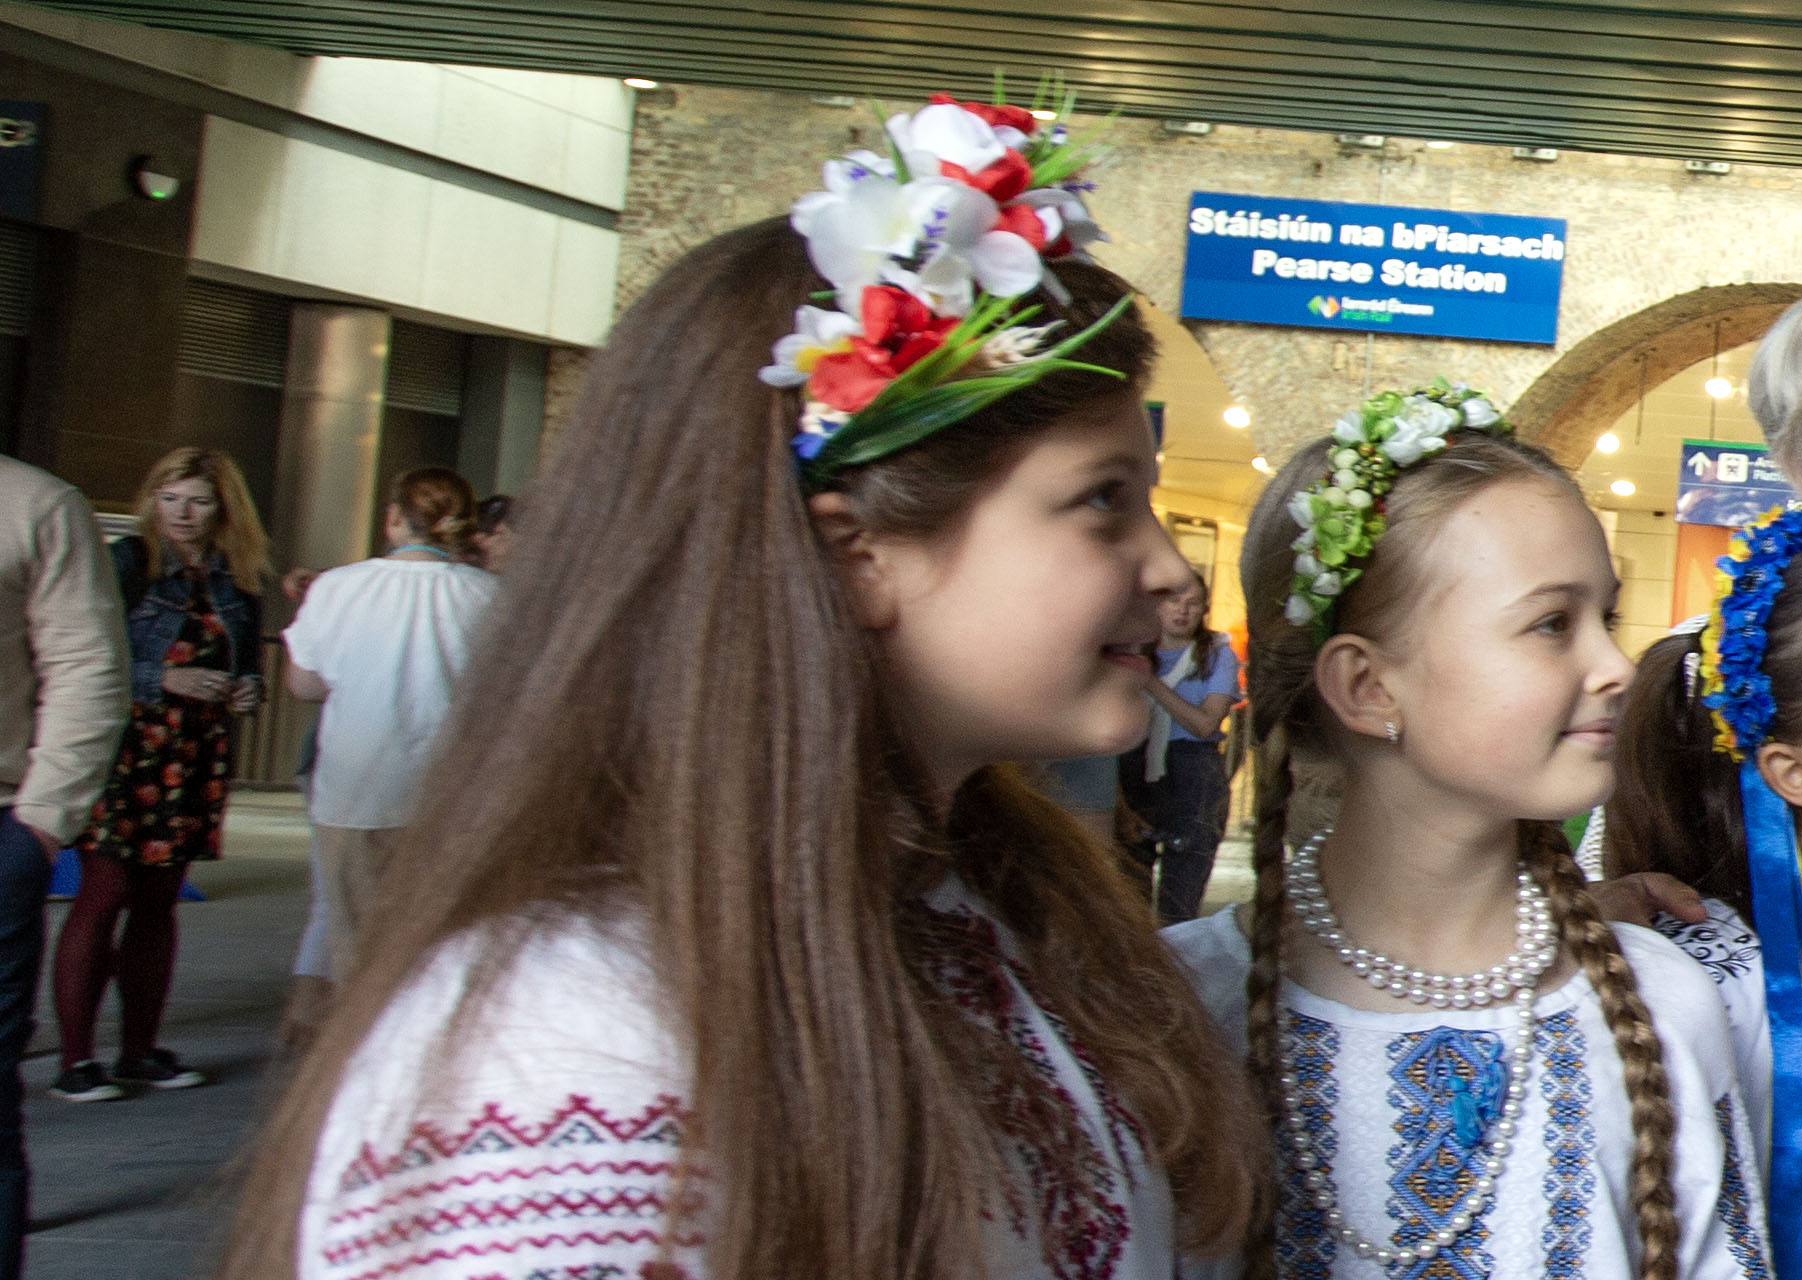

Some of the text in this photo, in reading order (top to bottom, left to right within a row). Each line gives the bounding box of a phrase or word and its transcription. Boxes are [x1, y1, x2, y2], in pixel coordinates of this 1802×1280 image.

[1188, 206, 1566, 261] Stáisiún na bPiarsach
[1251, 249, 1508, 294] Pearse Station
